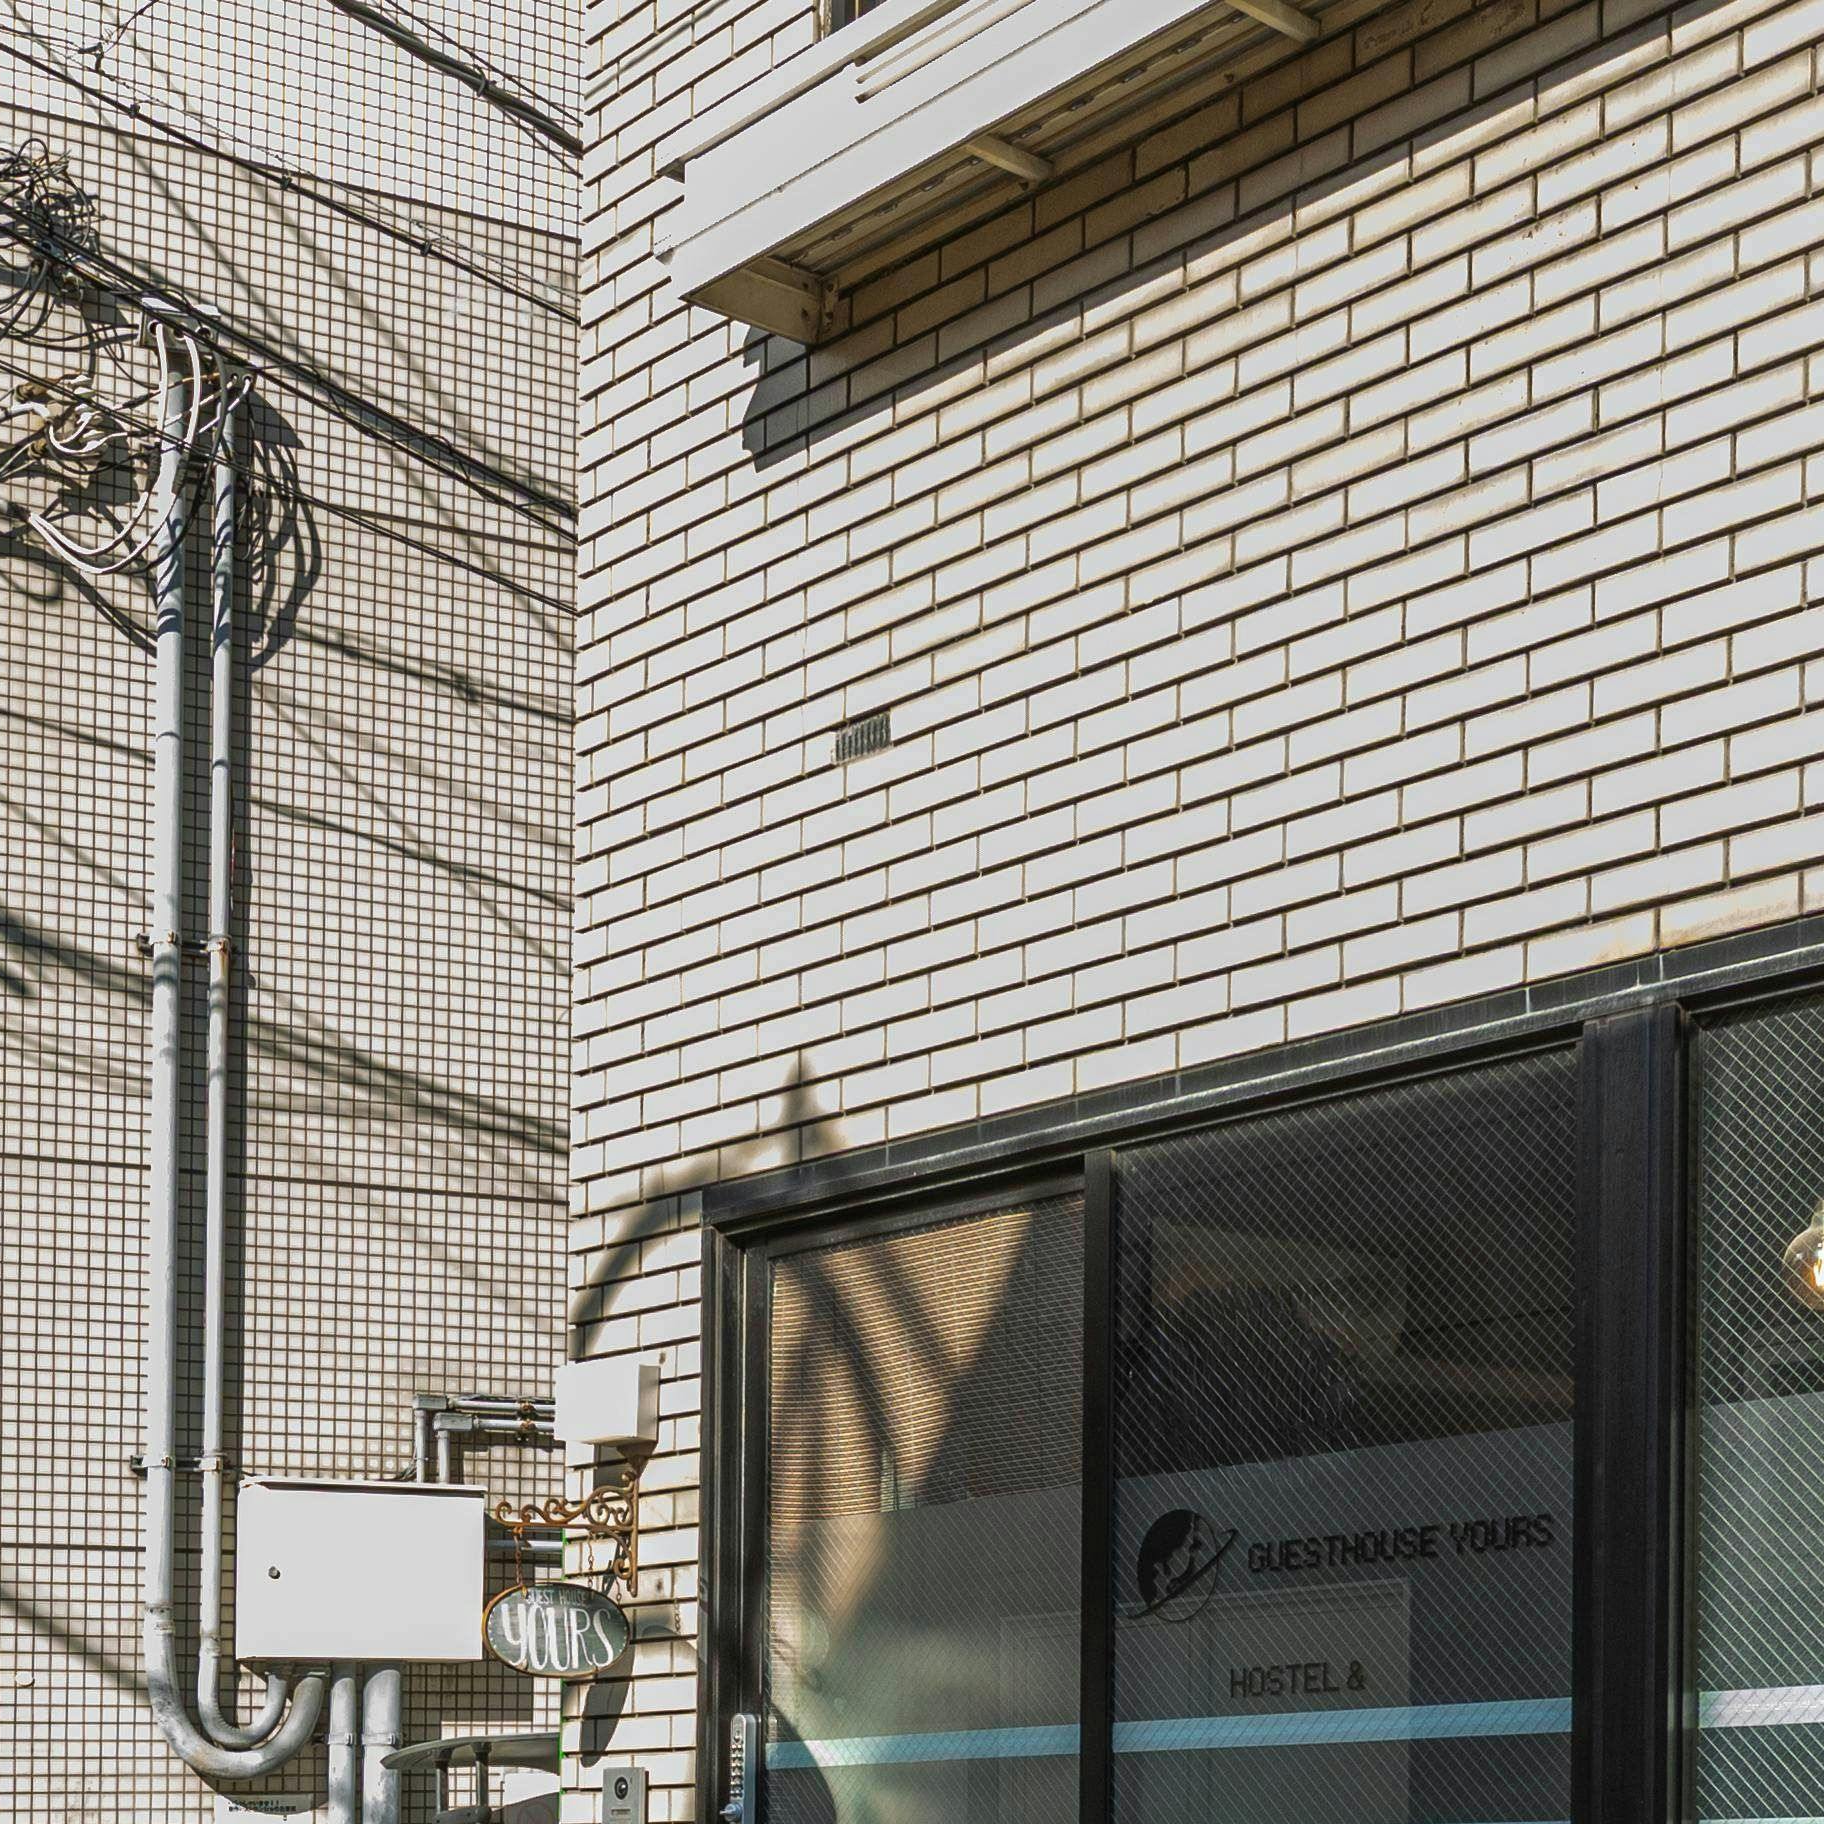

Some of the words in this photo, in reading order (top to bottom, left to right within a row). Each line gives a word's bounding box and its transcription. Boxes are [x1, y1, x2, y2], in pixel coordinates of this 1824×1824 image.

[1248, 1525, 1439, 1573] GUESTHOUSE
[1450, 1514, 1554, 1556] YOURS
[501, 1603, 614, 1672] YOURS
[1230, 1662, 1340, 1698] HOSTEL
[1346, 1660, 1366, 1691] &
